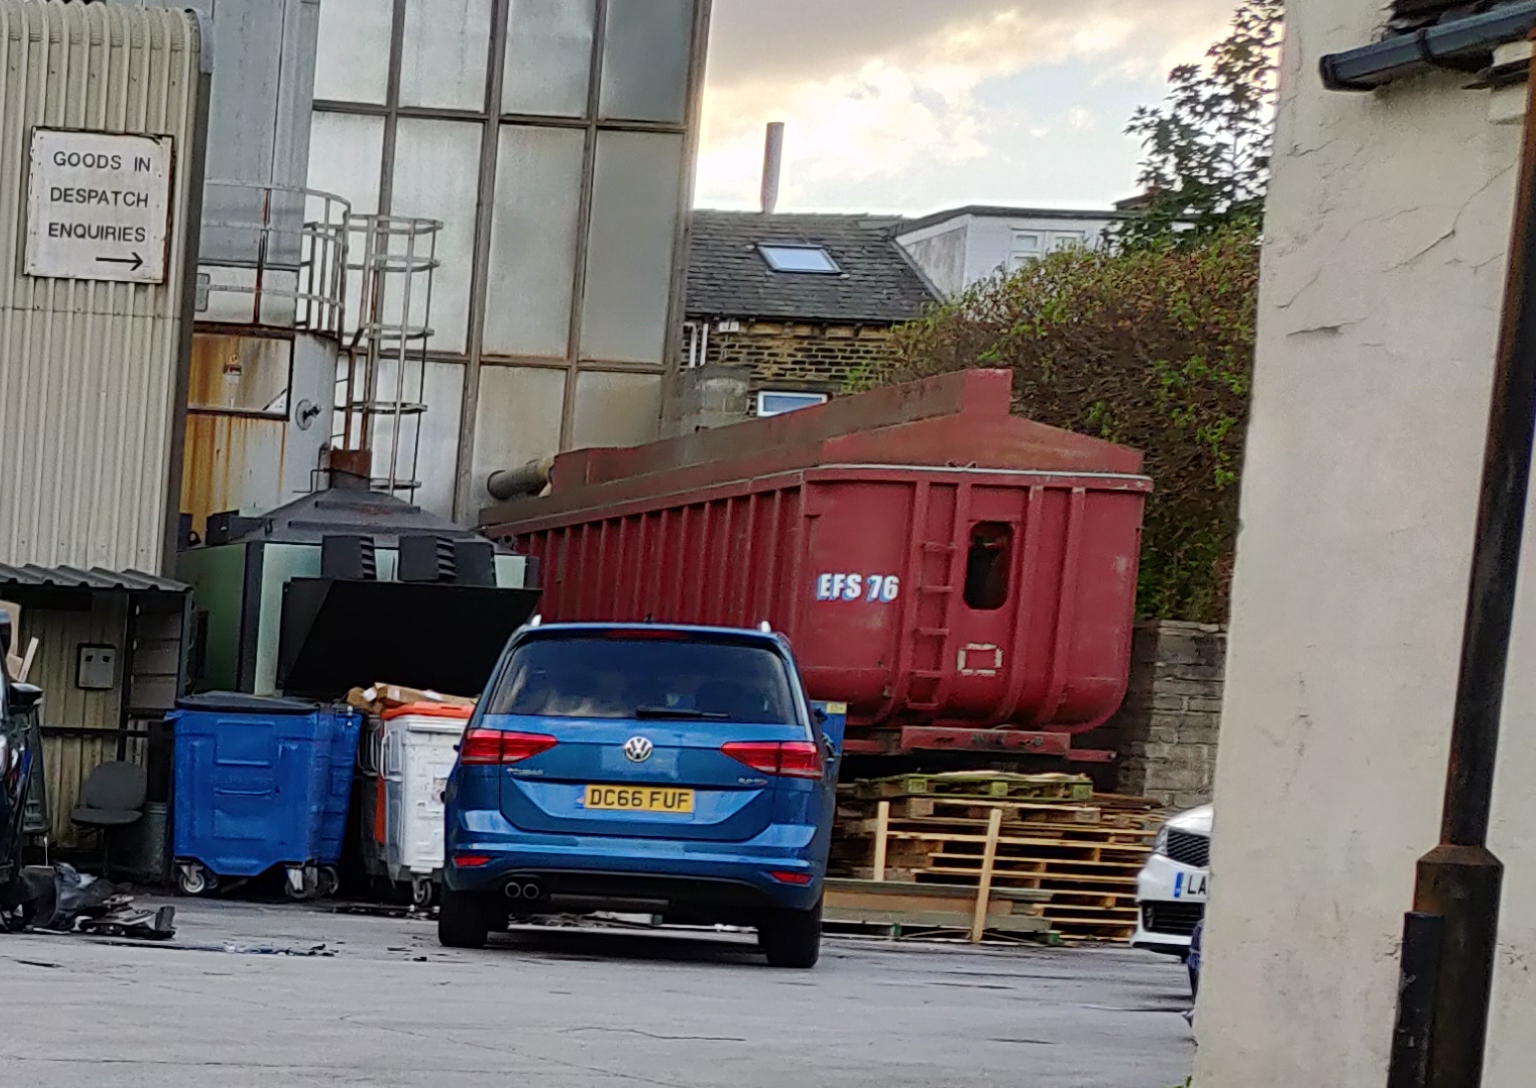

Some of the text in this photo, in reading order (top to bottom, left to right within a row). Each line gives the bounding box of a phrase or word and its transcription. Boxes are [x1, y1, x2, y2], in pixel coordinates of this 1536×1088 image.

[53, 151, 151, 172] GOODS IN
[50, 187, 149, 208] DESPATCH
[48, 222, 146, 242] ENQUIRIES
[817, 573, 899, 602] EFS 76
[589, 788, 690, 809] DC66 FUF
